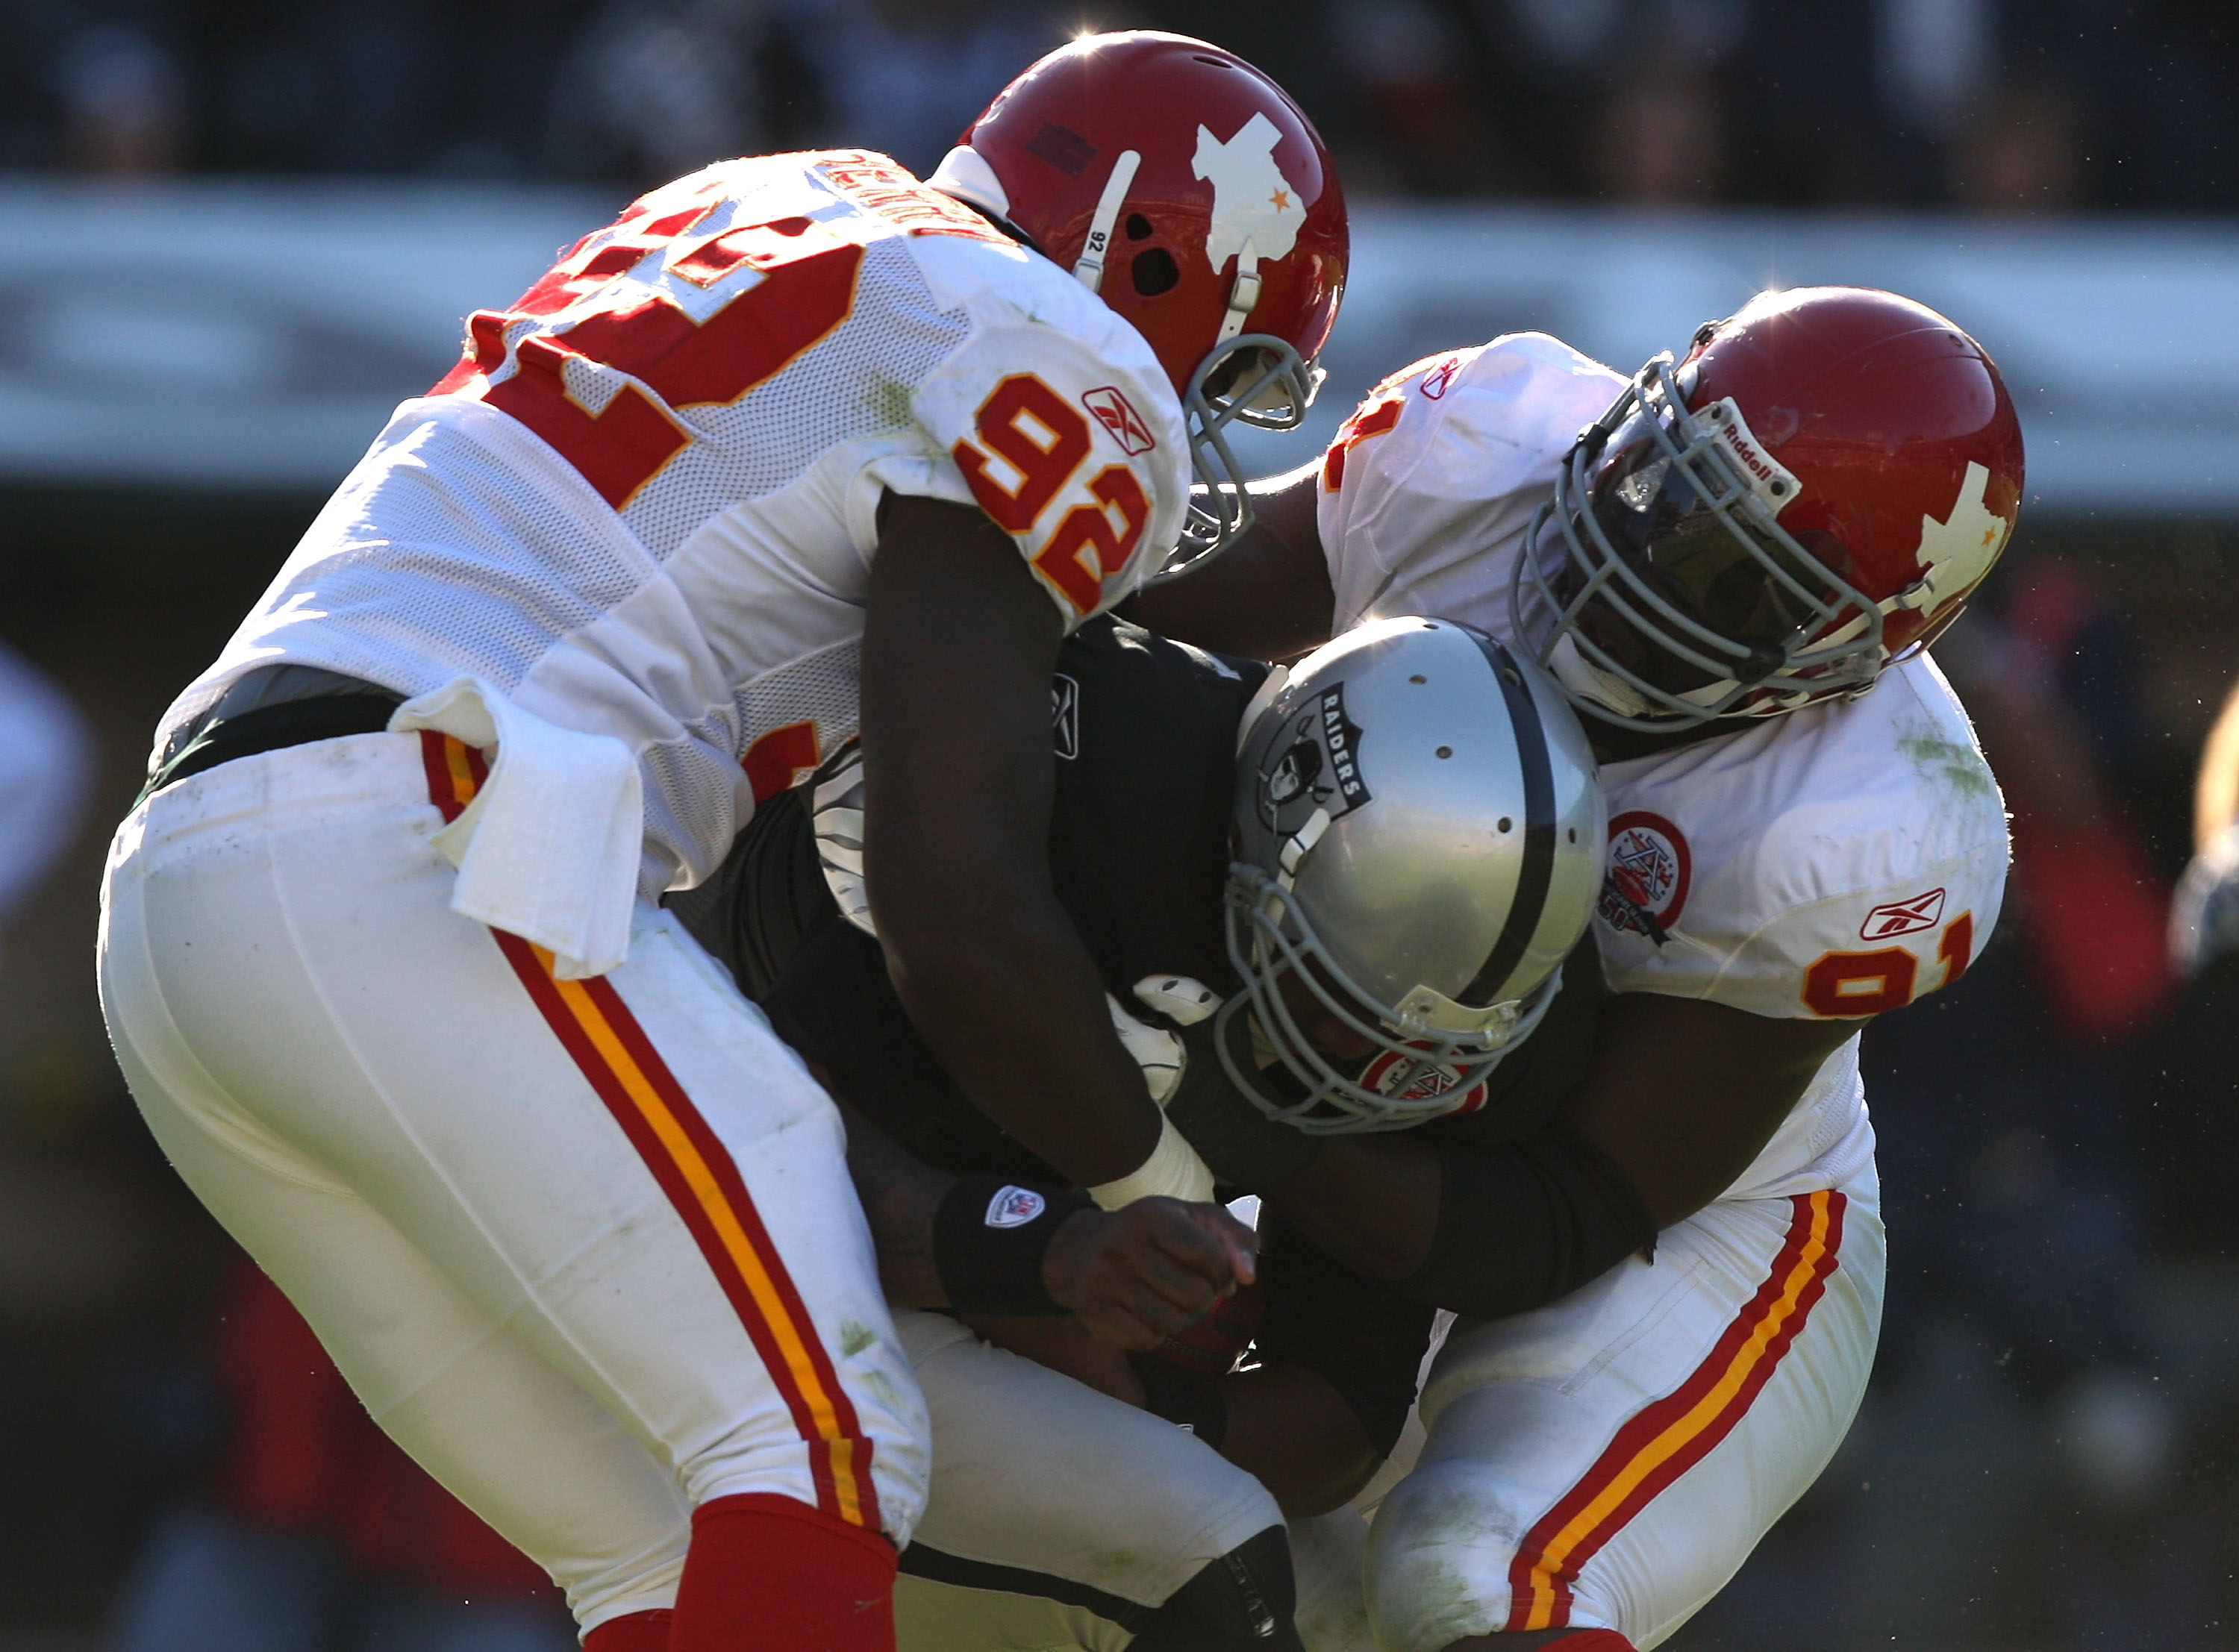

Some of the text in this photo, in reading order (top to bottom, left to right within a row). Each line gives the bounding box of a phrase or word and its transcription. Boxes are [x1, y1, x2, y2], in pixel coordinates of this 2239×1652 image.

[1088, 231, 1106, 252] 92
[1723, 423, 1773, 481] Riddell
[951, 372, 1154, 617] 92
[1323, 693, 1361, 796] RAIDERS
[1597, 894, 1629, 932] 50
